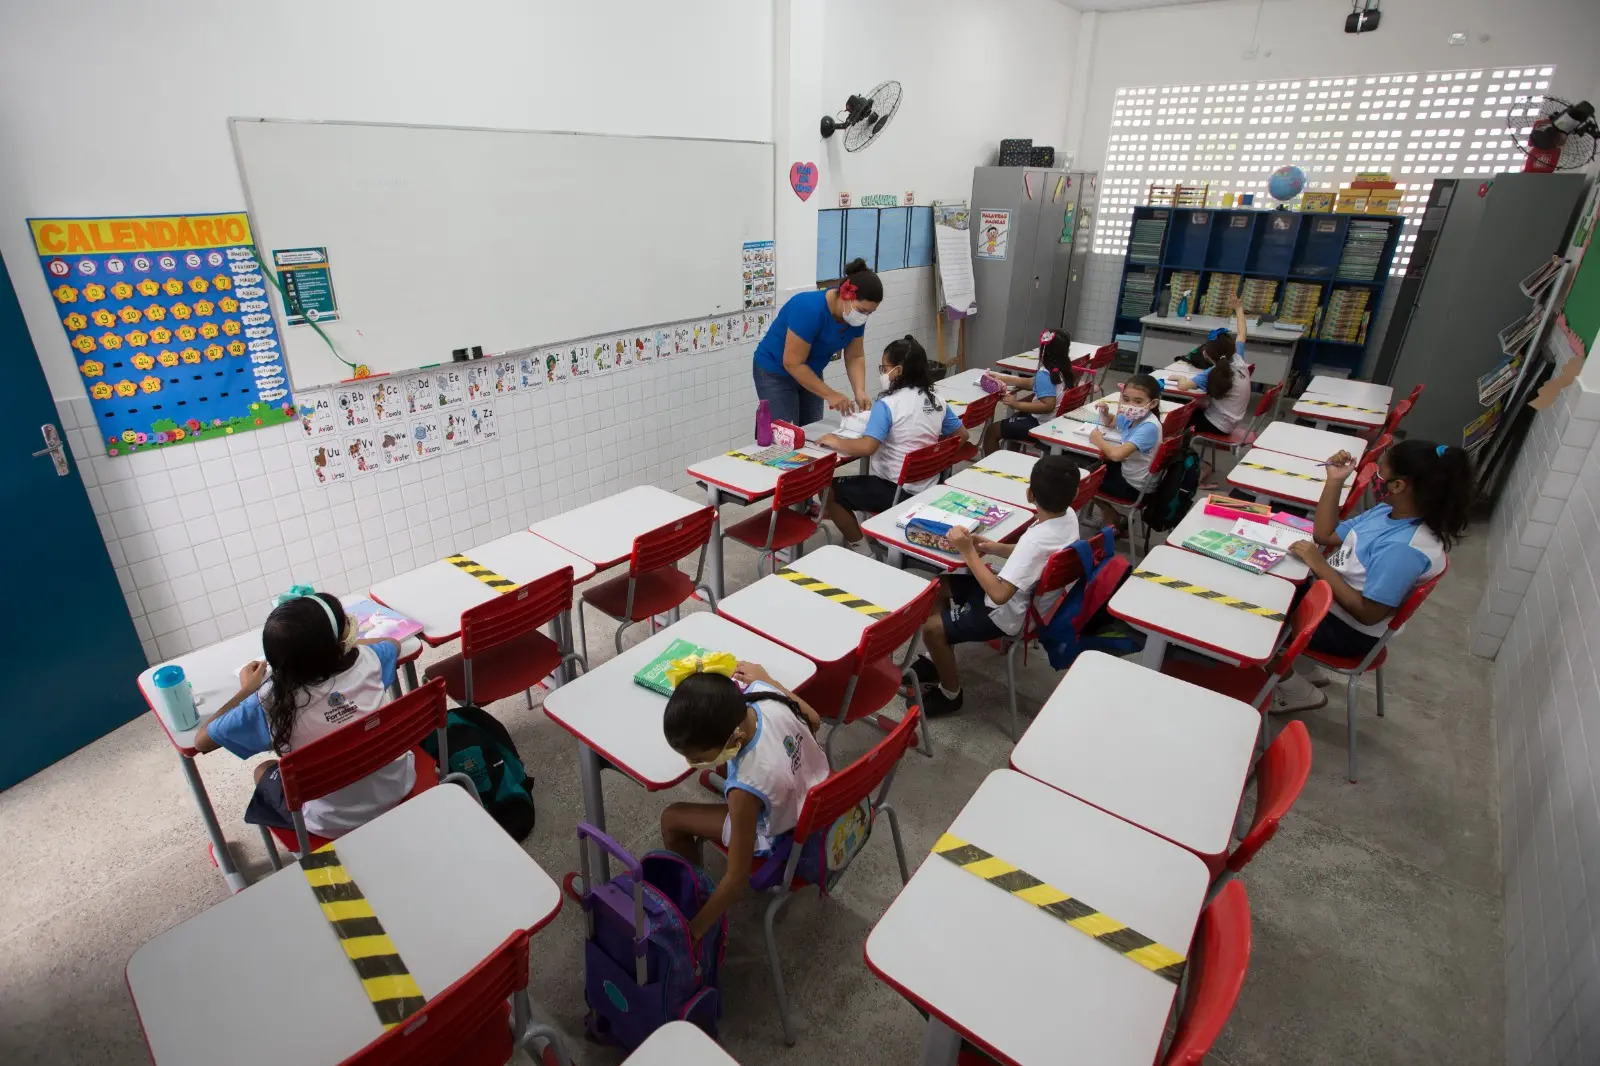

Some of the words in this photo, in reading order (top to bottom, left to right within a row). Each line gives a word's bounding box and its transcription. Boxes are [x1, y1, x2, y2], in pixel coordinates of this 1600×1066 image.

[40, 216, 245, 253] CALENDÁRIO
[57, 263, 64, 274] D
[84, 262, 91, 272] S
[112, 261, 120, 271] T
[138, 259, 148, 268] Q
[163, 258, 173, 267] Q
[190, 256, 198, 265] S
[212, 254, 219, 264] S
[63, 290, 69, 299] 1
[120, 287, 126, 295] 3
[146, 284, 153, 292] 4
[171, 283, 178, 292] 5
[196, 281, 202, 289] 6
[219, 278, 226, 287] 7
[73, 317, 81, 327] 8
[101, 315, 108, 324] 9
[126, 311, 136, 319] 10
[151, 308, 161, 317] 11
[176, 307, 186, 315] 12
[201, 304, 209, 312] 13
[226, 301, 234, 309] 14
[80, 339, 90, 348] 15
[107, 337, 117, 346] 16
[133, 335, 143, 343] 17
[228, 324, 237, 332] 21
[580, 348, 588, 358] Jj
[87, 365, 98, 373] 22
[138, 358, 149, 366] 24
[185, 352, 195, 360] 26
[210, 348, 219, 357] 27
[233, 345, 241, 353] 28
[477, 366, 487, 377] Ff
[505, 363, 515, 374] Gg
[448, 373, 459, 383] Ee
[96, 387, 108, 395] 29
[146, 381, 157, 389] 31
[418, 379, 429, 389] Dd
[386, 386, 398, 395] Cc
[352, 392, 364, 402] Bb
[316, 400, 328, 409] Aa
[483, 409, 493, 418] Zz
[455, 417, 466, 426] Yy
[318, 425, 334, 433] Avião
[426, 424, 437, 432] Xx
[361, 440, 373, 449] Vv
[327, 448, 340, 458] Uu
[393, 453, 410, 462] Wafer
[331, 472, 345, 480] Urso
[325, 705, 358, 722] Fortaleza
